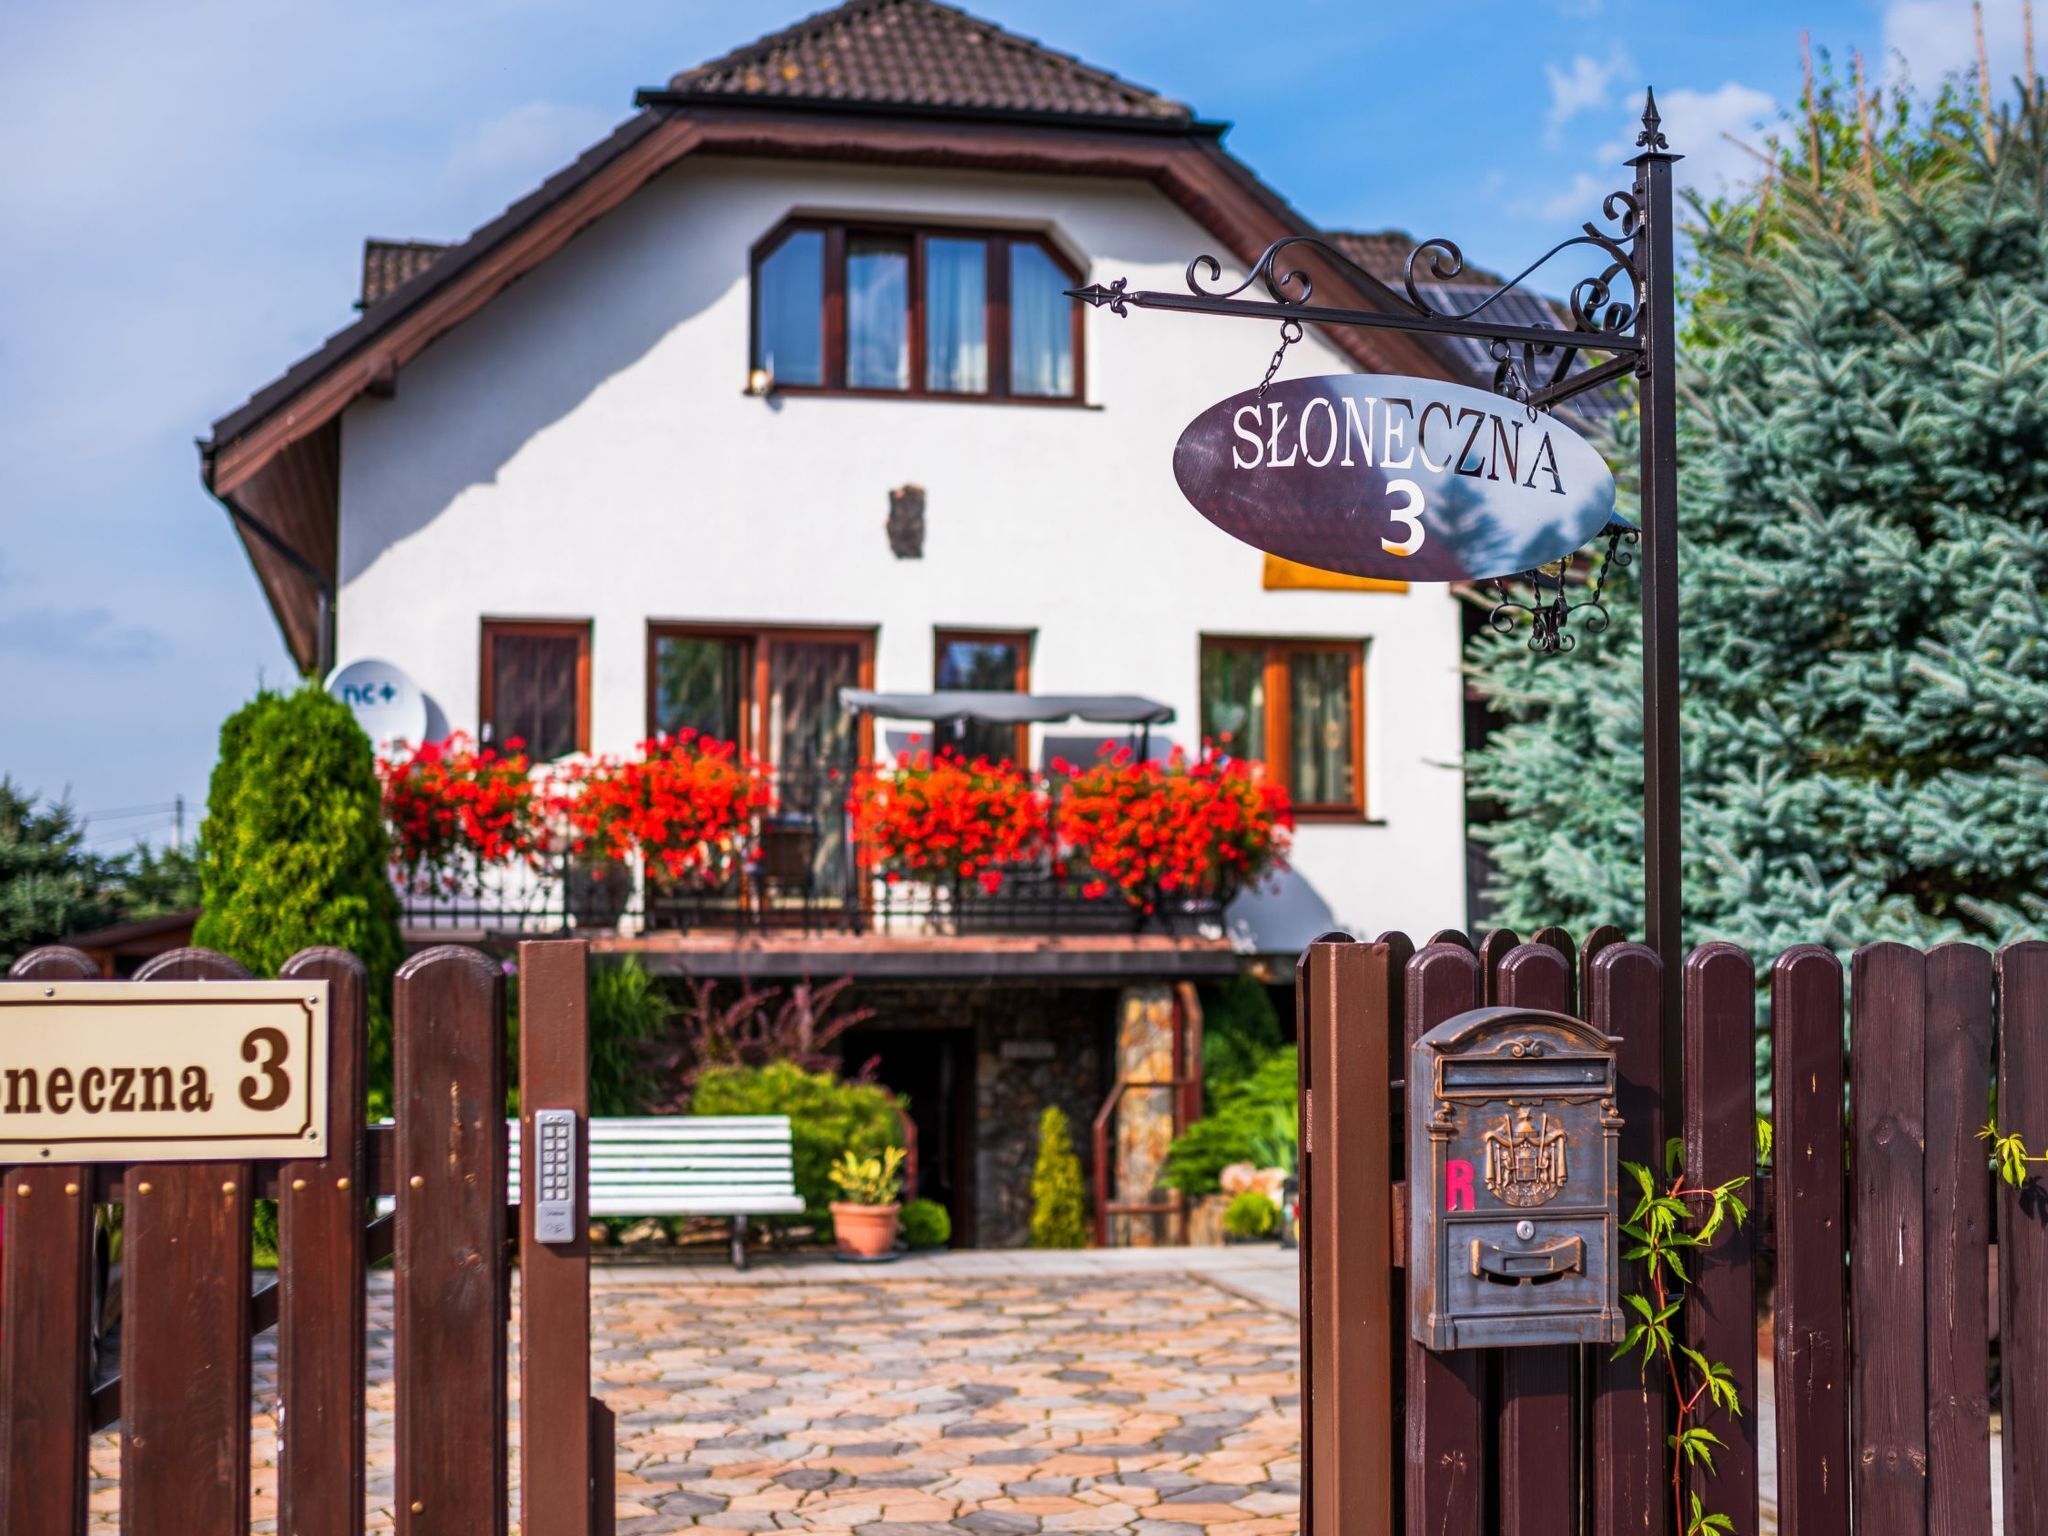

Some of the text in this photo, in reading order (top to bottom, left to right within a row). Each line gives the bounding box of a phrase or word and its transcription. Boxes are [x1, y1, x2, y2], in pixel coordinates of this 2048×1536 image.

[1232, 396, 1567, 496] SŁONECZNA
[1381, 479, 1426, 556] 3
[0, 1026, 291, 1114] neczna 3
[1445, 1159, 1476, 1212] R
